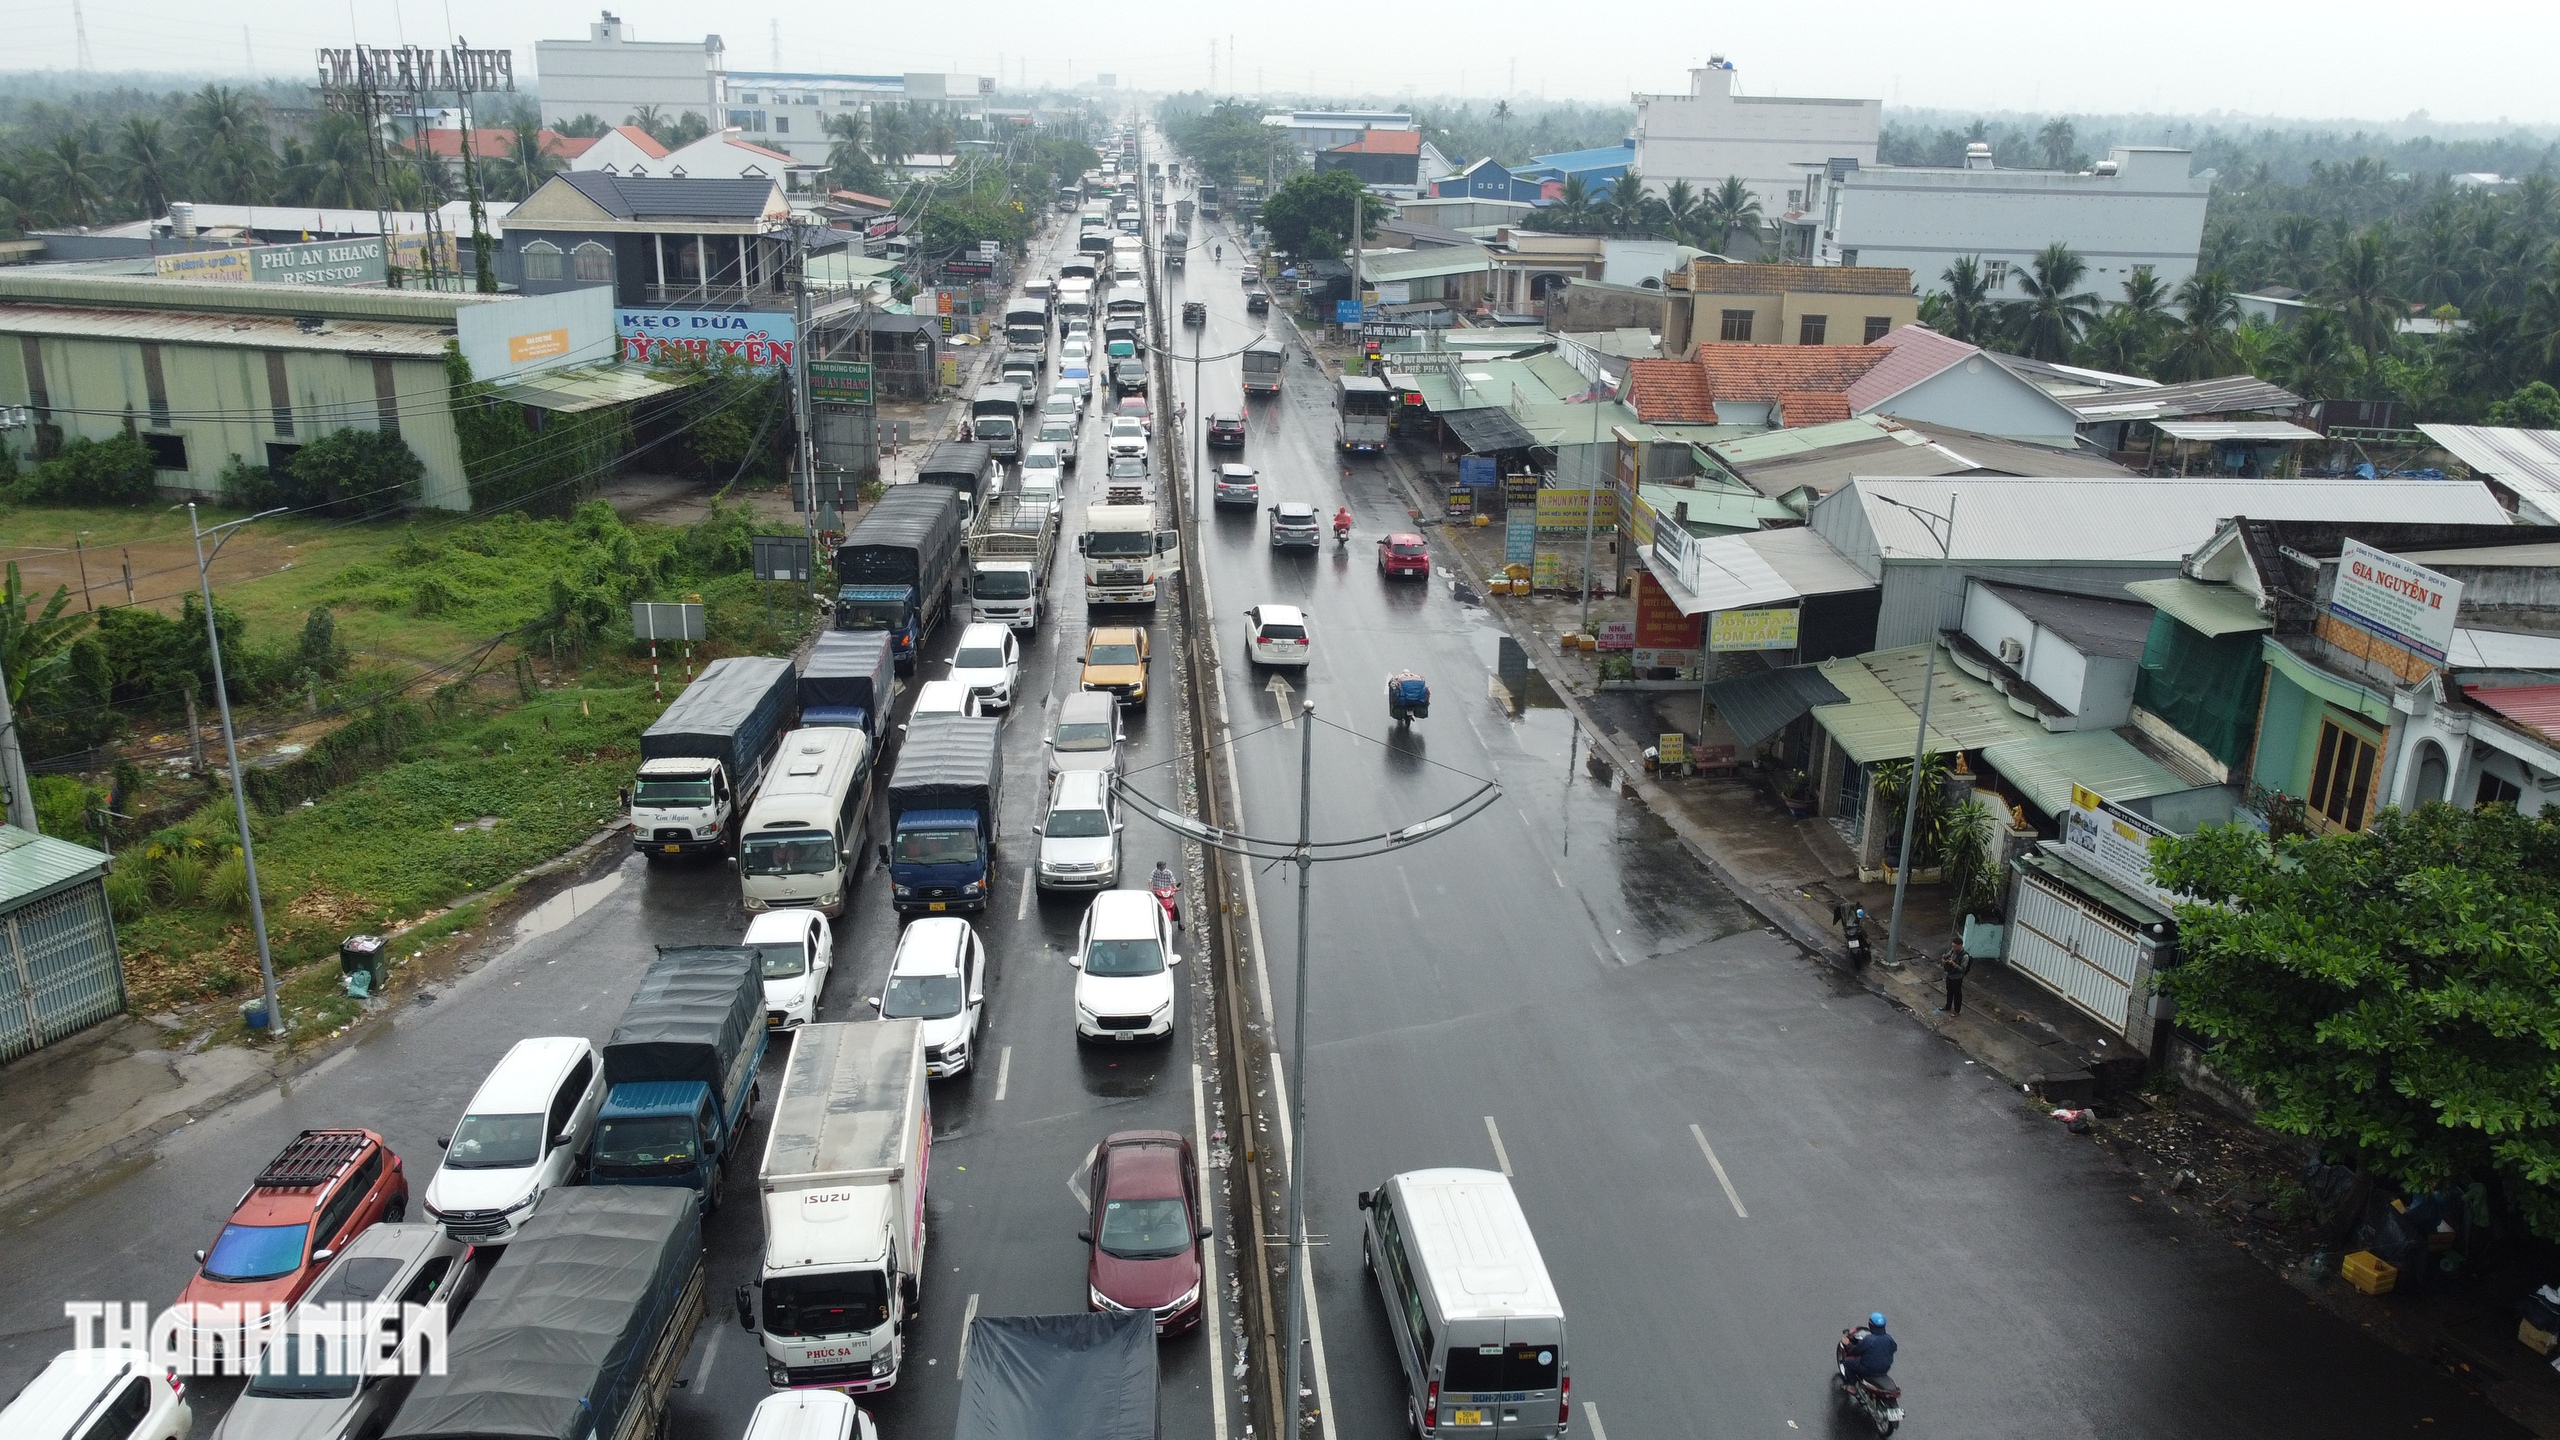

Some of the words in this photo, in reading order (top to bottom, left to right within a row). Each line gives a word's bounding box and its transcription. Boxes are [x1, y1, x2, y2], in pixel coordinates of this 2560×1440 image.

[260, 248, 295, 269] PHÚ
[300, 250, 322, 266] AN
[327, 243, 379, 263] KHANG
[282, 265, 363, 284] RESTSTOP
[622, 315, 681, 330] KẸO
[691, 314, 749, 330] DỪA
[1364, 325, 1373, 336] CÀ
[1385, 327, 1397, 336] PHA
[1397, 326, 1411, 337] MÁY
[718, 331, 795, 368] YẾN
[811, 364, 829, 373] TRẠM
[1423, 365, 1440, 373] PHA
[809, 374, 826, 388] PHÚ
[828, 377, 839, 389] AN
[840, 377, 869, 391] KHANG
[2352, 561, 2373, 581] GIA
[2375, 570, 2429, 603] NGUYỄN
[1608, 624, 1626, 633] NHÀ
[1615, 631, 1633, 640] THUÊ
[804, 1193, 851, 1204] ISUZU
[806, 1346, 835, 1359] PHÚC
[837, 1348, 851, 1357] SA
